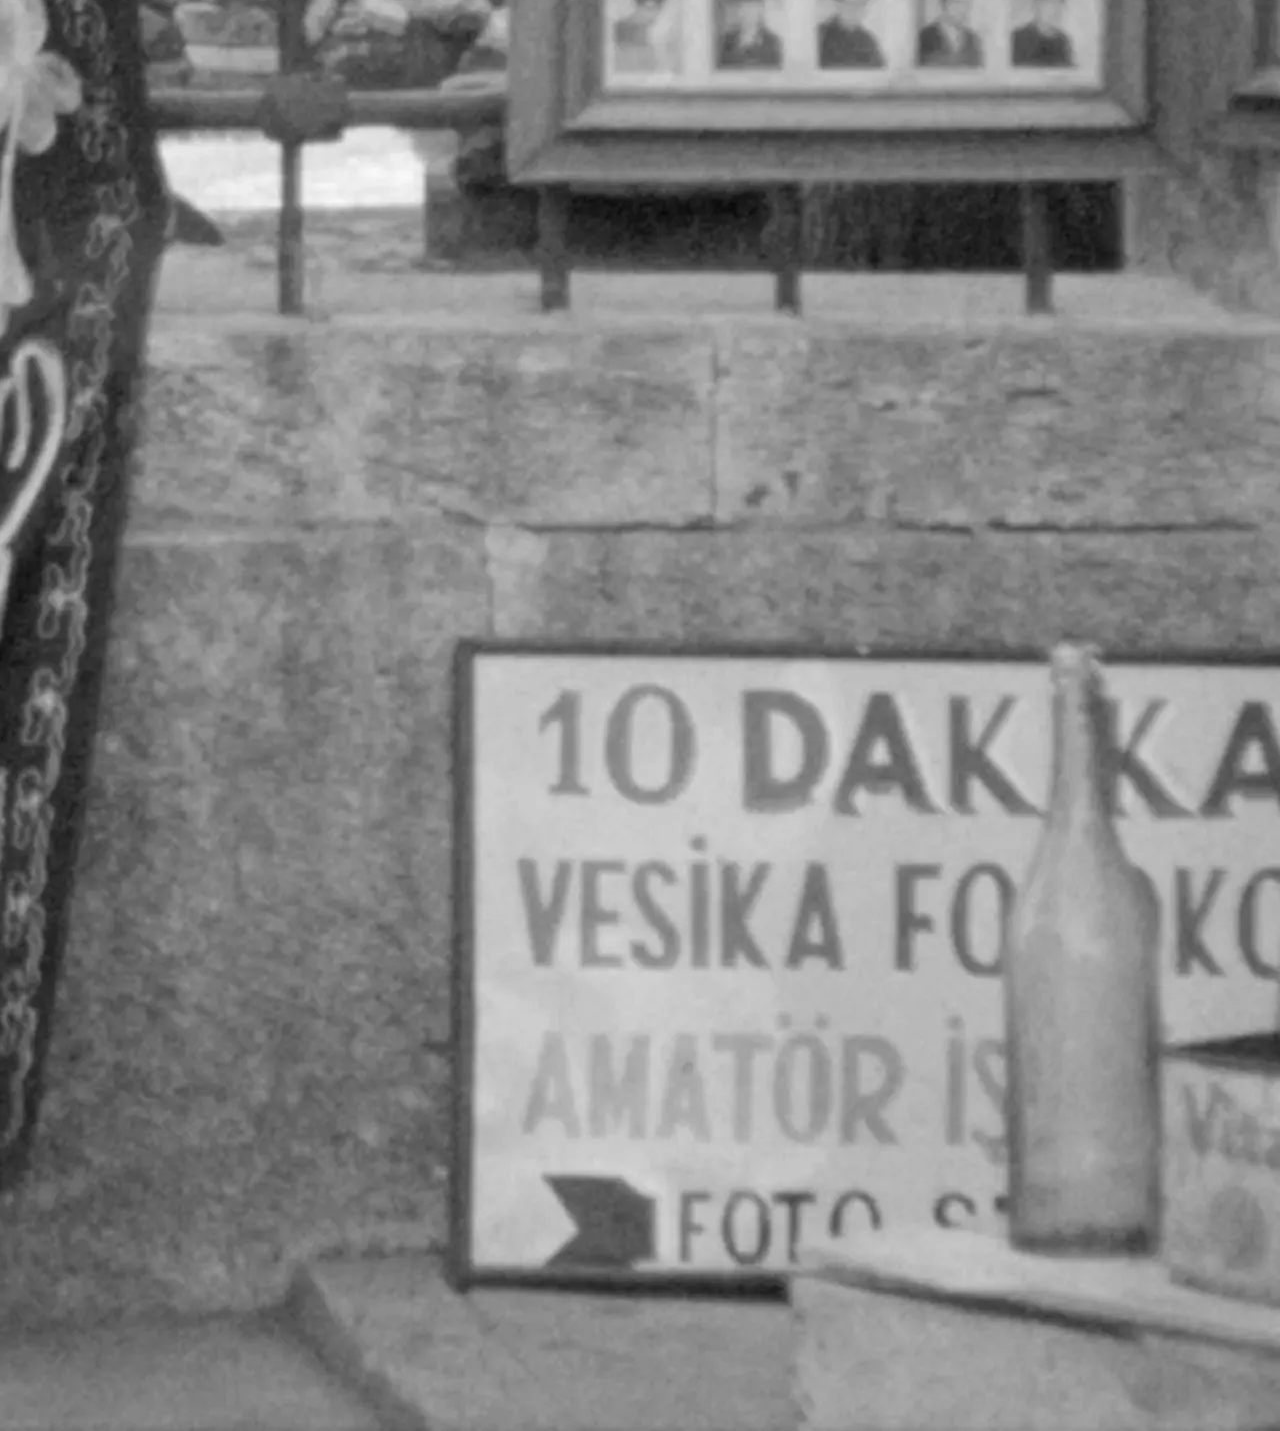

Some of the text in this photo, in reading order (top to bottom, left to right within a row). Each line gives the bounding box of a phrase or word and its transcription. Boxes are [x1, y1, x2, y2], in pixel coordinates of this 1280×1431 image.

[538, 683, 1280, 819] 10 DAKKA
[518, 835, 843, 972] VESİKA
[520, 1014, 904, 1148] AMATÖR
[678, 1189, 882, 1266] FOTO
